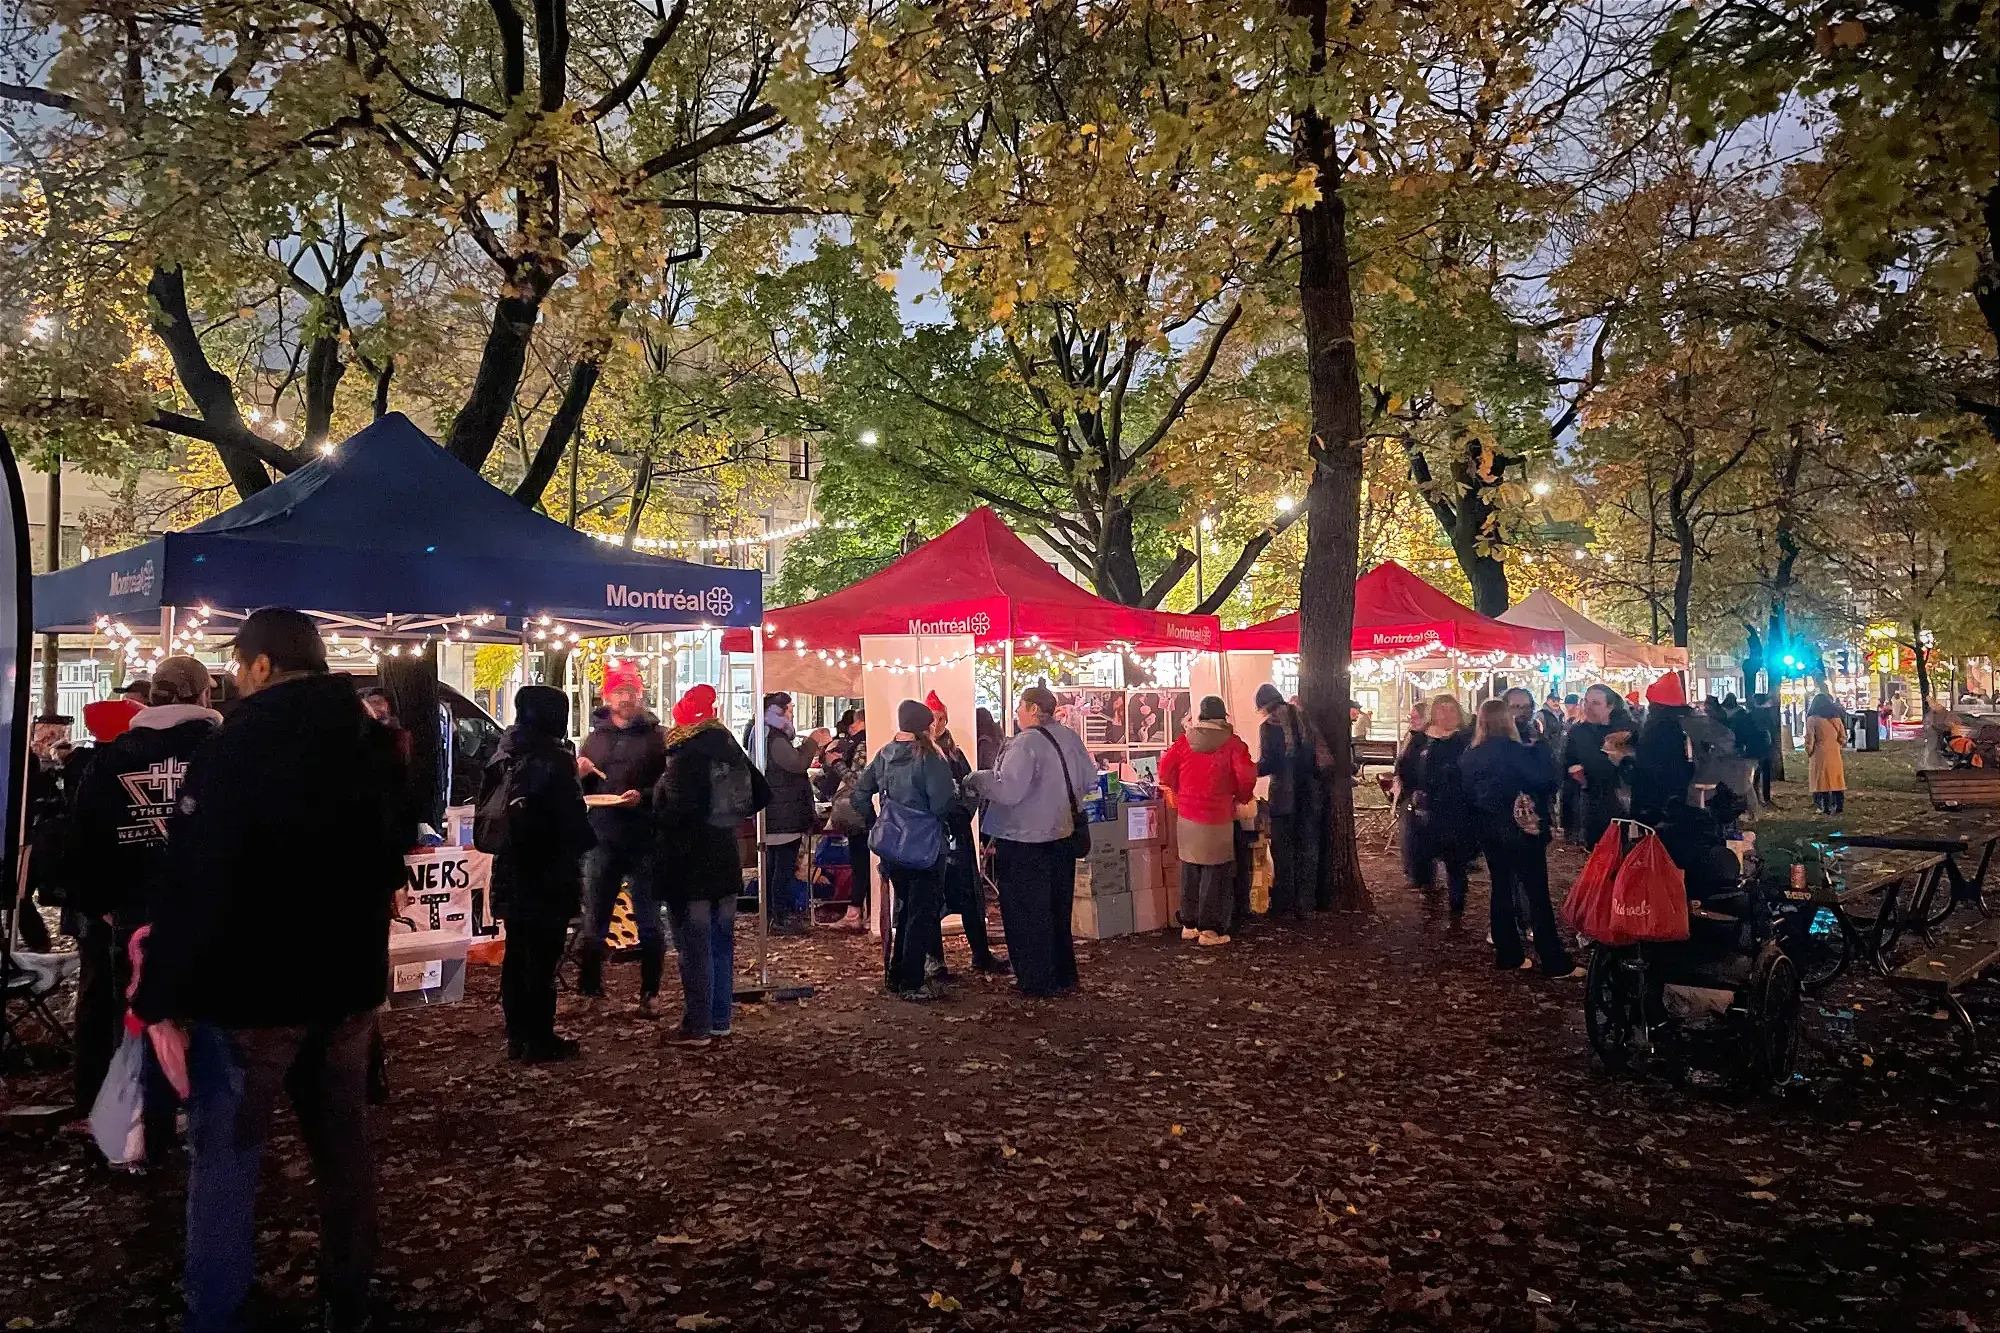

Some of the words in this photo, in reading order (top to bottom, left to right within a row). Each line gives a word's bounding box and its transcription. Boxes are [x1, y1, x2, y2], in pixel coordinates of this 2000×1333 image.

[606, 584, 705, 612] Montréal
[908, 616, 970, 635] Montréal
[1166, 622, 1202, 641] Montréal
[1373, 632, 1423, 644] Montréal
[140, 807, 162, 816] THE
